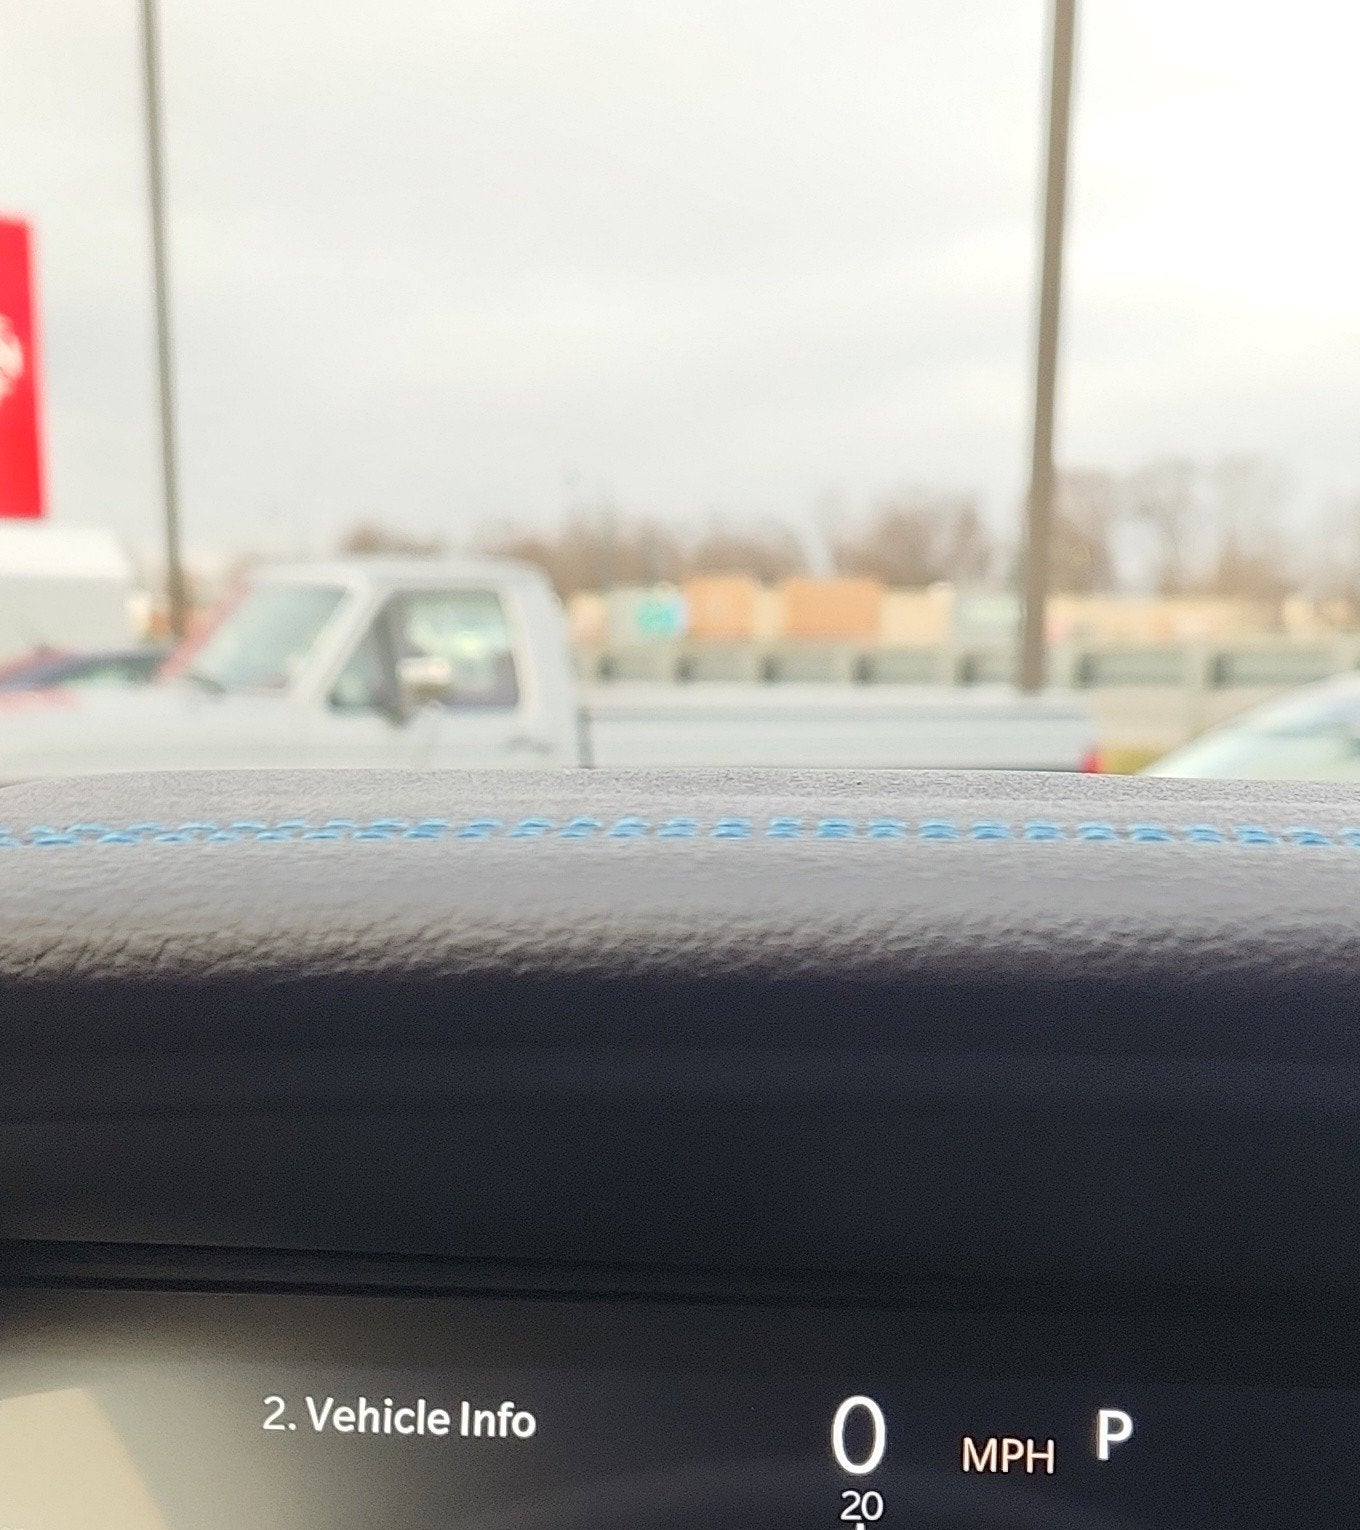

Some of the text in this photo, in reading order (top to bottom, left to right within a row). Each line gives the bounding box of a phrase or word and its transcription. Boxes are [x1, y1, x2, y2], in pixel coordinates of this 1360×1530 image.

[262, 1395, 537, 1438] 2. Vehicle Info
[832, 1395, 1055, 1475] 0 MPH
[1098, 1409, 1134, 1461] P
[840, 1490, 884, 1521] 20
